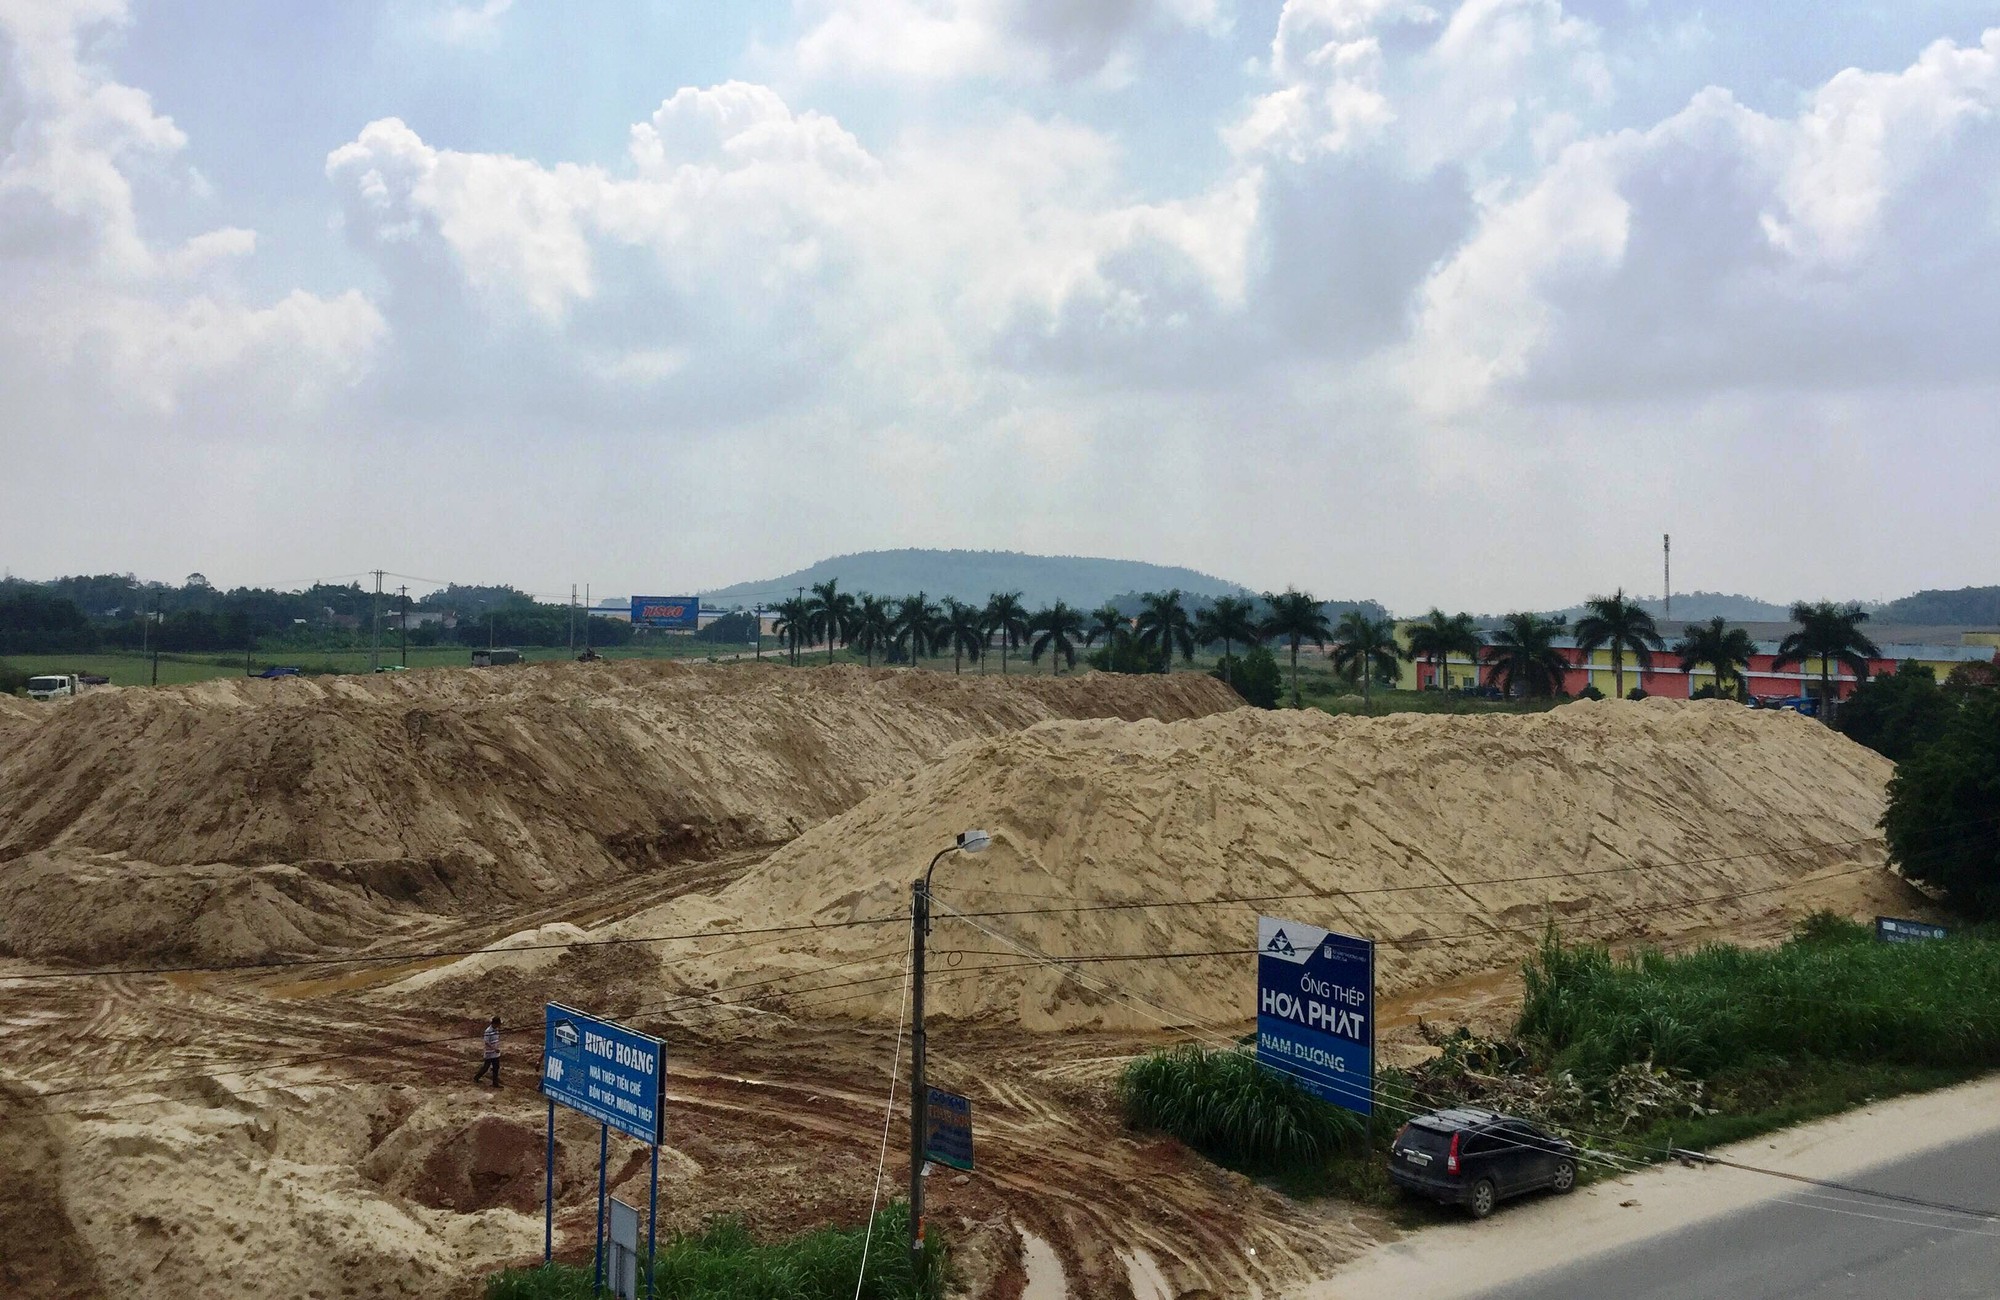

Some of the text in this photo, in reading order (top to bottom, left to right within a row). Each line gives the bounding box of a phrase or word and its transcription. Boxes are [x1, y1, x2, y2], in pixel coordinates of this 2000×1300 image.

[1300, 972, 1365, 1007] ỐNG THÉP
[1308, 1000, 1365, 1040] PHÁT
[615, 1042, 654, 1075] HOÀNG
[1261, 1032, 1291, 1056] NAM
[602, 1069, 616, 1086] THÉP
